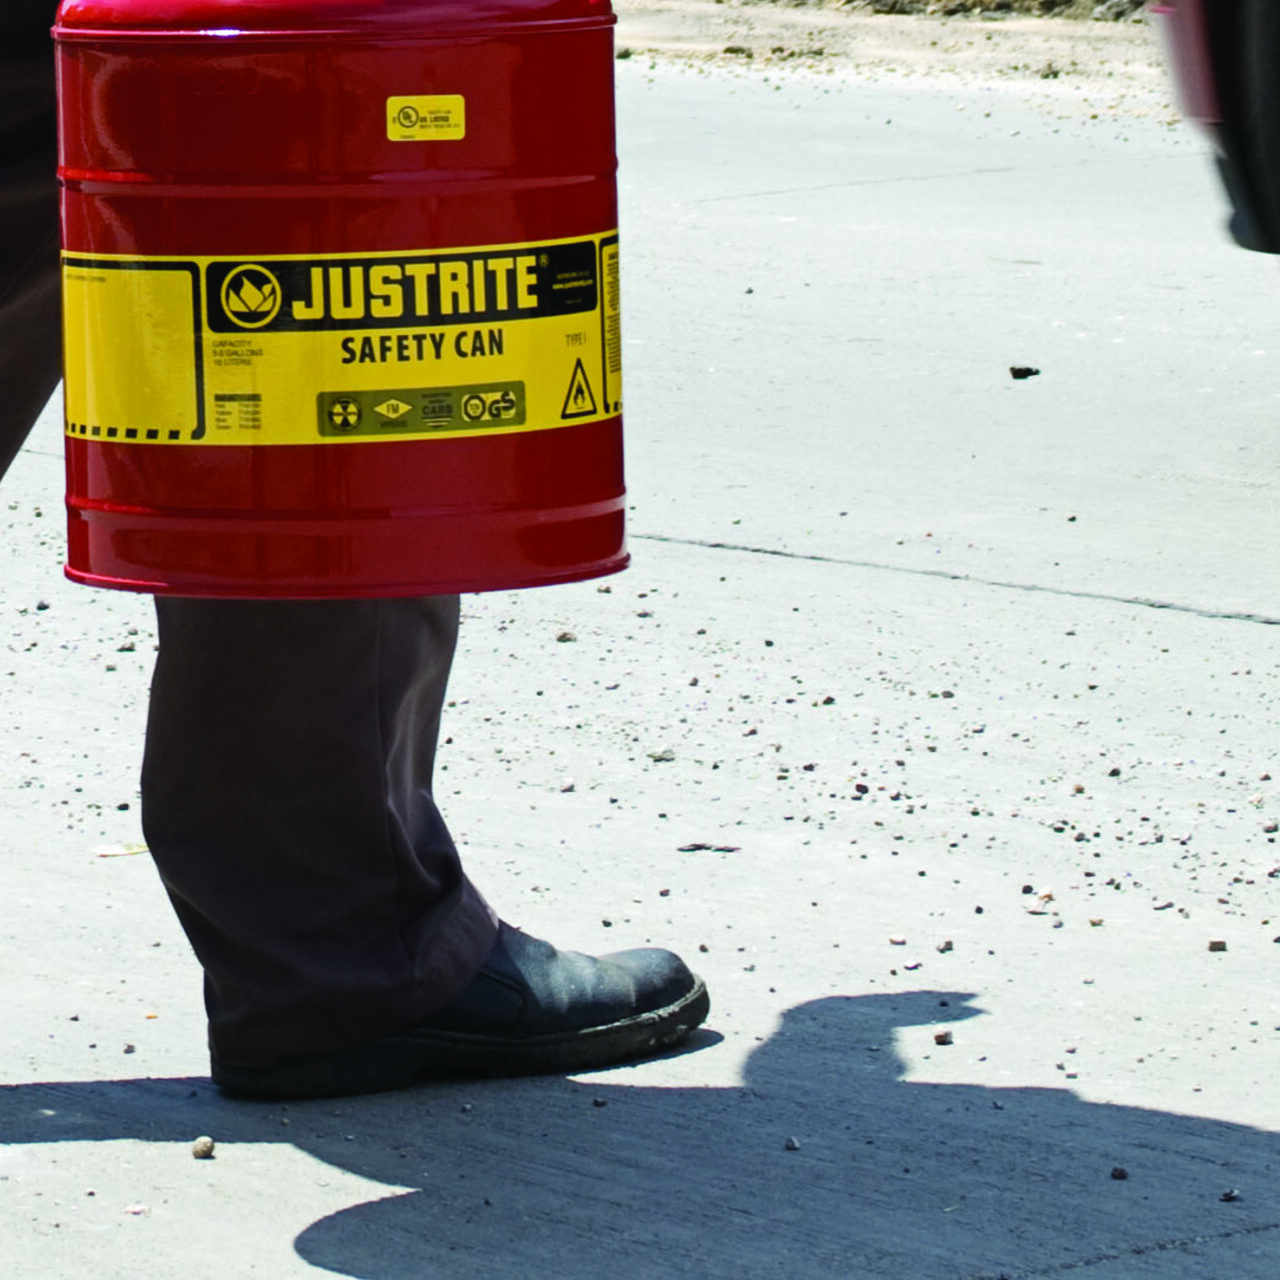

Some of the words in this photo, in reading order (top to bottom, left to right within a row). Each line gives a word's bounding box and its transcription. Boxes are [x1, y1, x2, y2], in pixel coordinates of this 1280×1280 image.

[341, 332, 445, 365] SAFETY
[454, 328, 504, 359] CAN
[565, 332, 582, 347] TYPE
